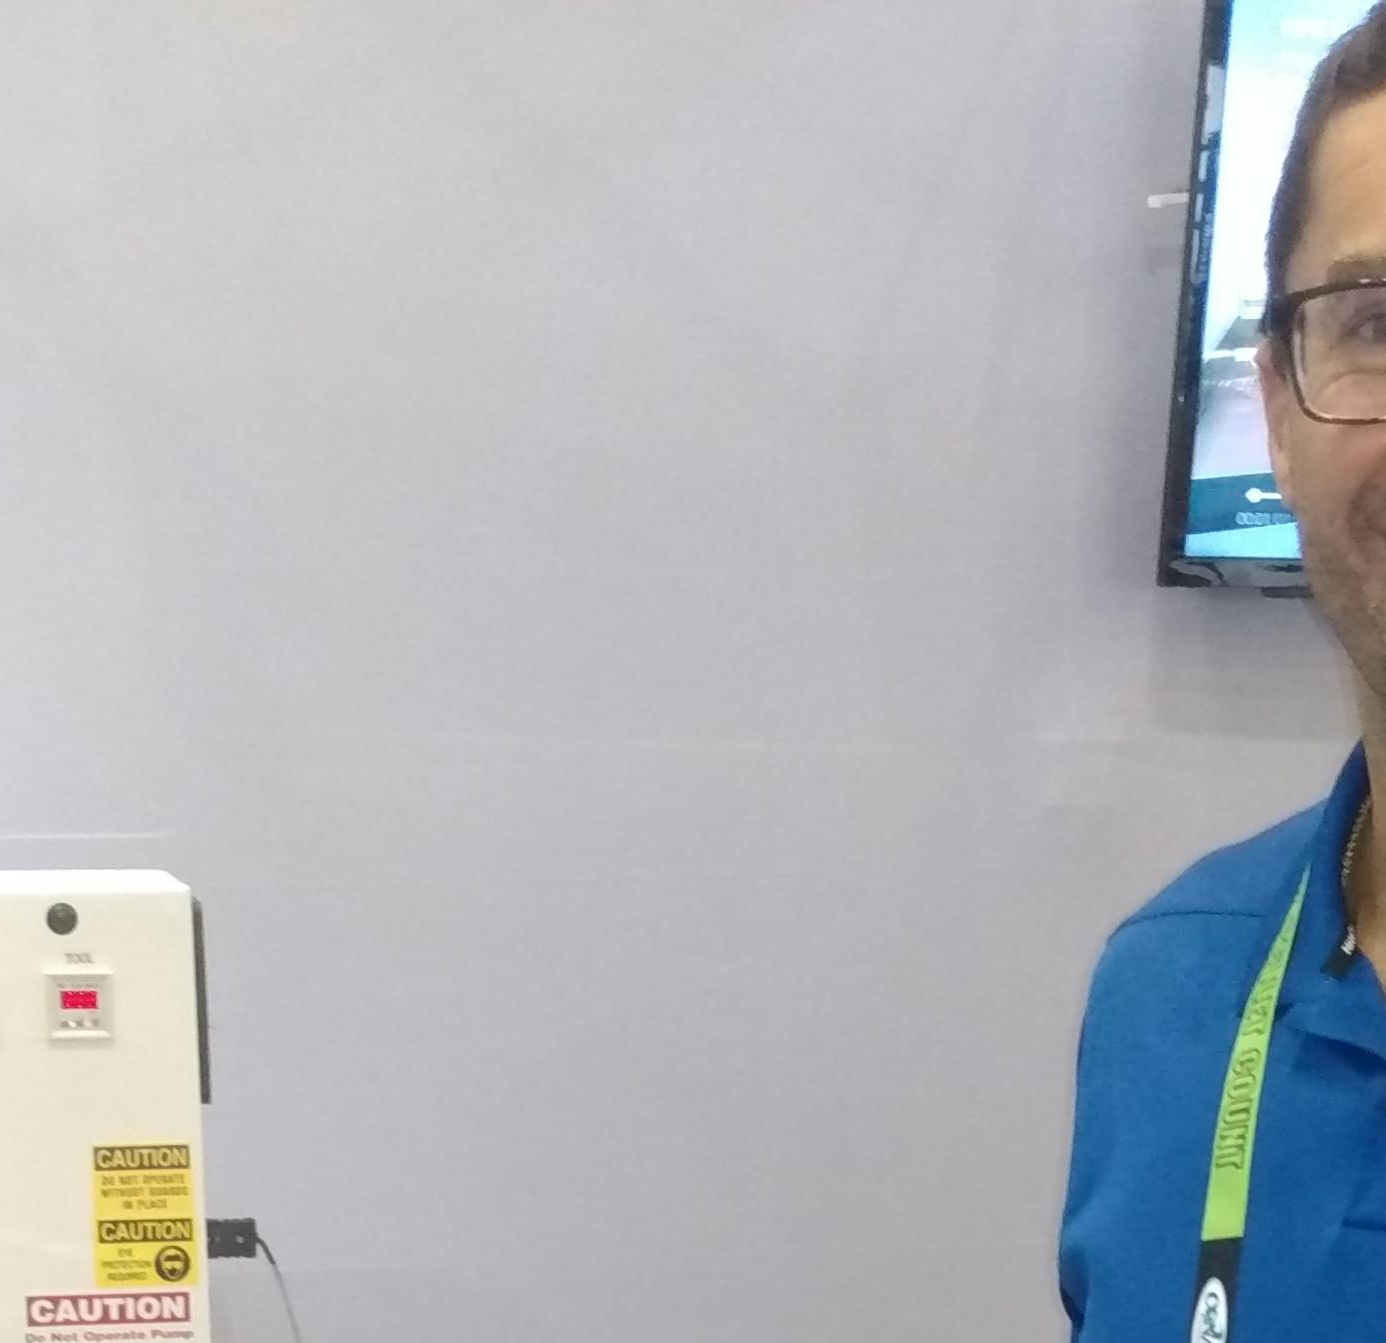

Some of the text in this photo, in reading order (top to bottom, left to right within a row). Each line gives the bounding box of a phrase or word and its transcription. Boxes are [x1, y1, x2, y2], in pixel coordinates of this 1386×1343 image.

[96, 1147, 188, 1168] CAUTION
[100, 1221, 191, 1242] CAUTION
[30, 1295, 187, 1324] CAUTION
[25, 1329, 194, 1343] Do Not Operate Pump
